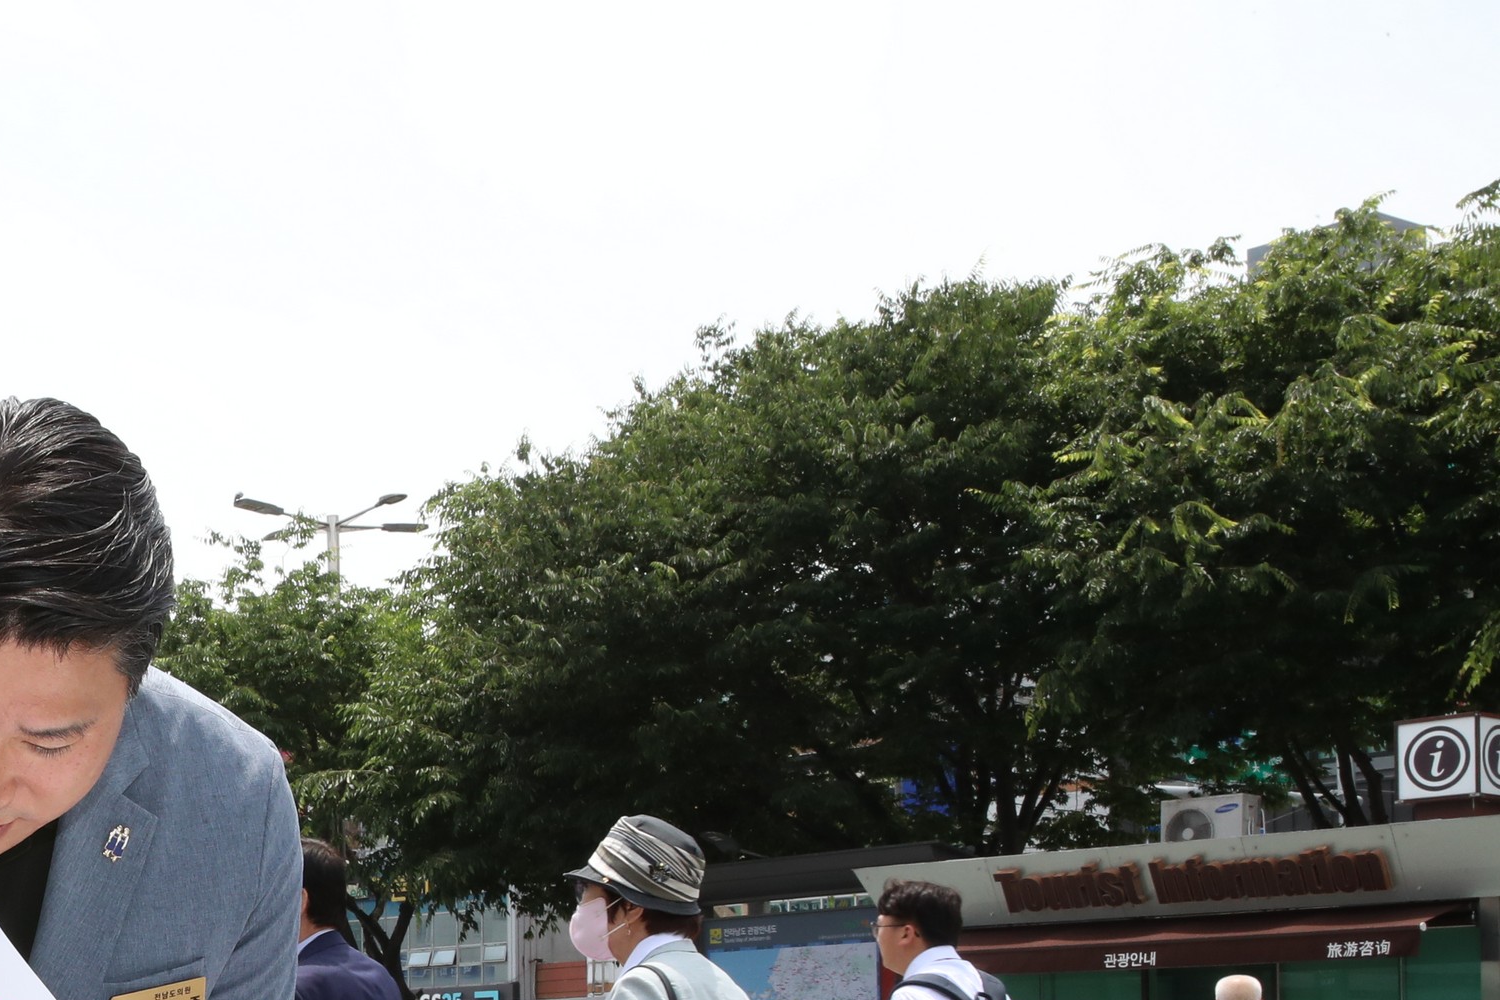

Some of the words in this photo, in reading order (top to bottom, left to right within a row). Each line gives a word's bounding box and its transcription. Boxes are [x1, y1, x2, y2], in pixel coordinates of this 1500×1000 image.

[993, 861, 1146, 914] Tourist
[1148, 845, 1393, 905] Information
[1327, 940, 1390, 959] 旅游咨询
[1104, 952, 1157, 968] 관광안내
[154, 986, 191, 1000] 전남도의원
